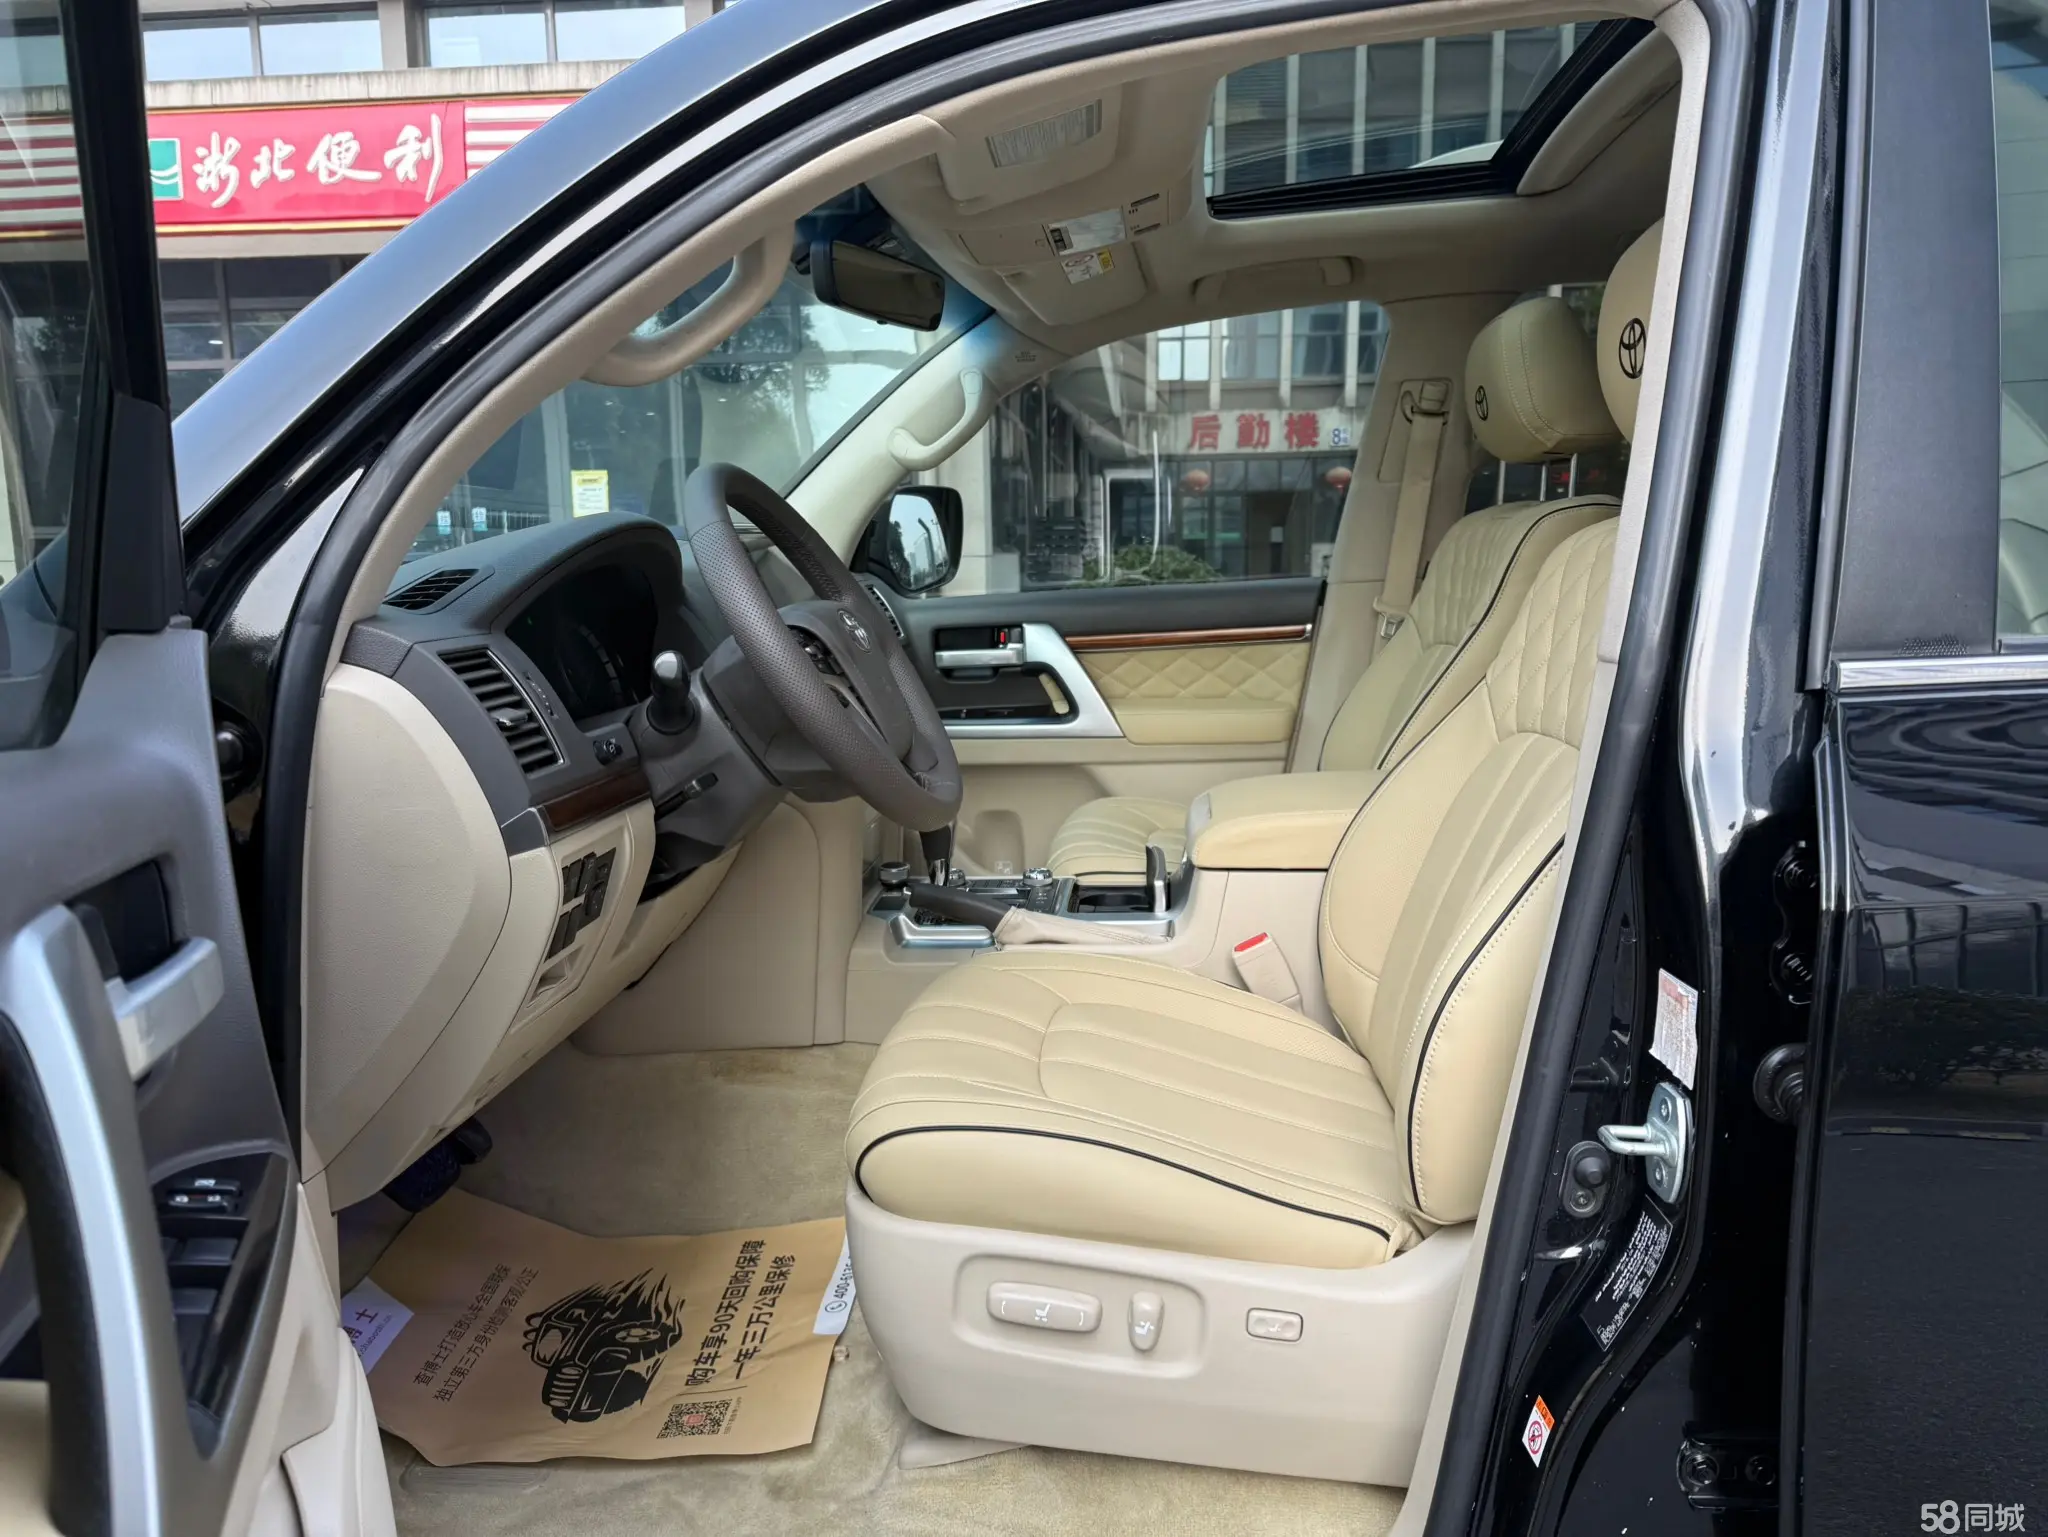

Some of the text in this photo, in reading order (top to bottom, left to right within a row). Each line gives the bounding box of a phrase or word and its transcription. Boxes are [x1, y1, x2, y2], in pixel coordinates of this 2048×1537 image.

[192, 113, 442, 208] 浙北便利
[684, 1240, 766, 1386] 购车享90天回购保障
[733, 1254, 796, 1380] 一年三万公里保修
